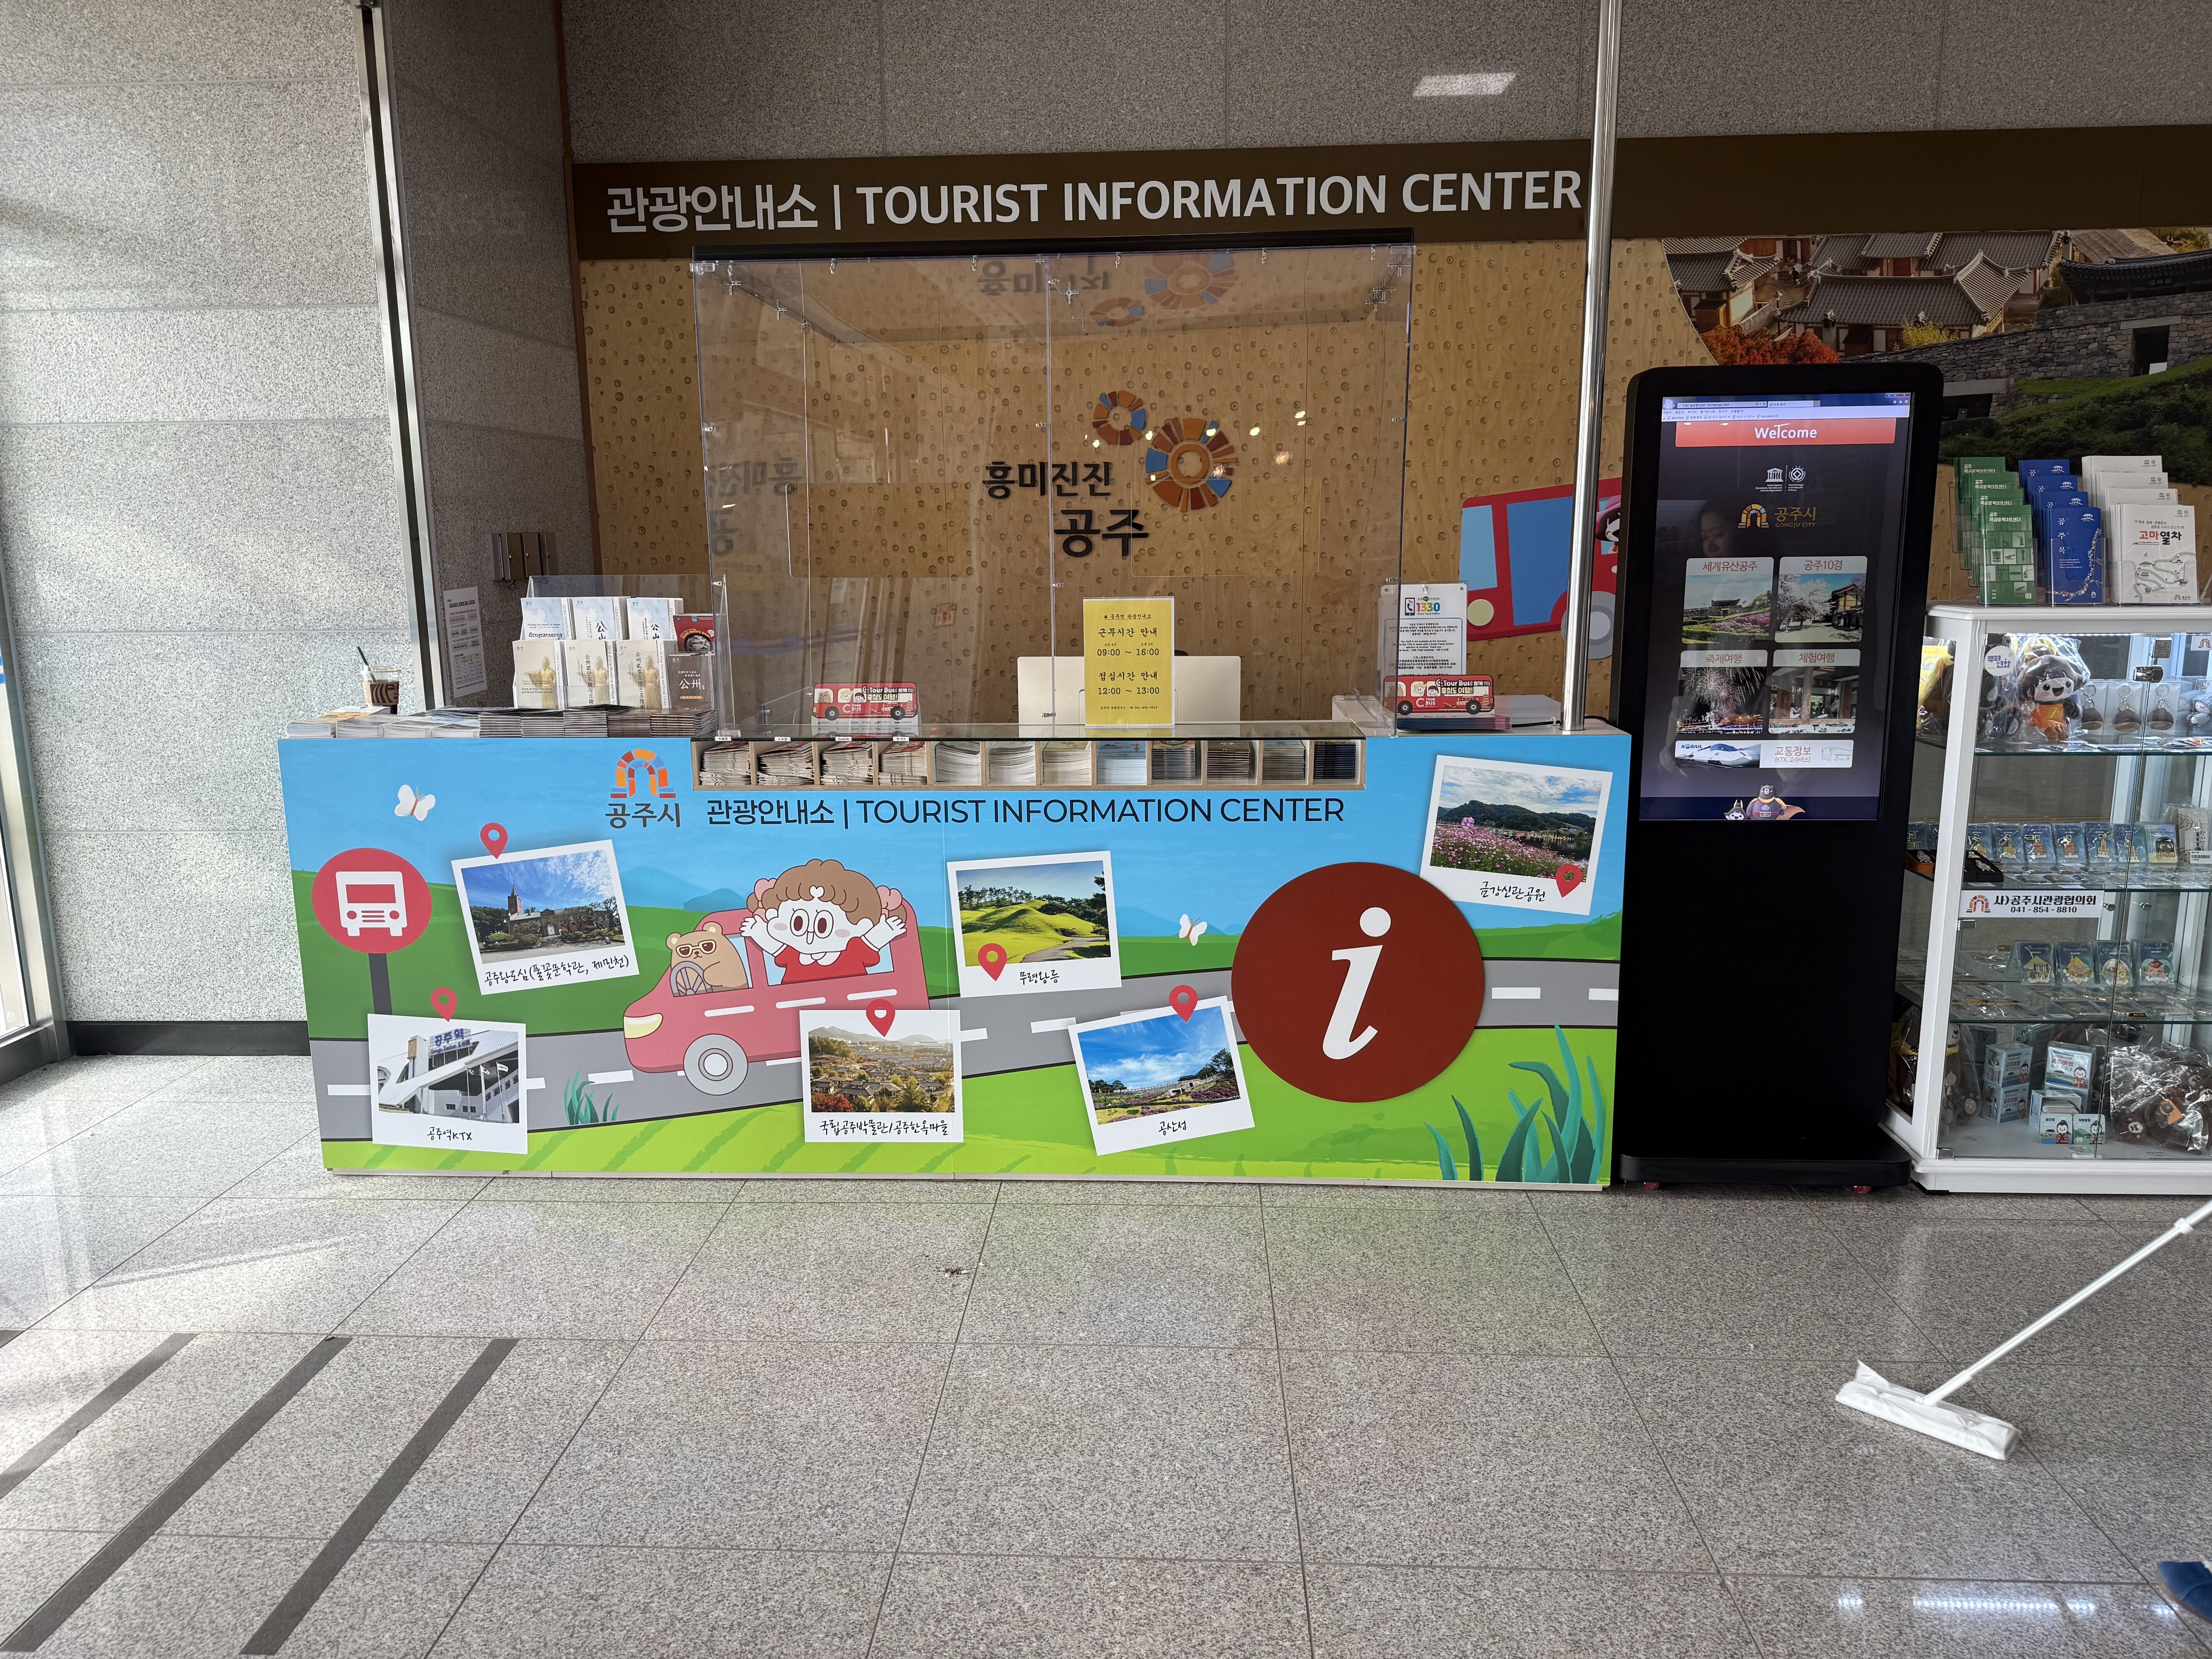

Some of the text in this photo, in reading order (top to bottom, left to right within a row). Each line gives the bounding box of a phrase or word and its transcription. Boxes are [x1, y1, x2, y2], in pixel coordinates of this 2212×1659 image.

[607, 184, 818, 233] 관광안내소
[856, 184, 1047, 225] TOURIST
[1064, 175, 1386, 221] INFORMATION
[1402, 170, 1582, 213] CENTER
[1755, 423, 1817, 440] Welcome
[982, 460, 1112, 499] 흥미진진
[1775, 507, 1816, 522] 공주시
[1054, 508, 1149, 558] 공주
[2139, 531, 2182, 545] 고마열차
[1702, 561, 1758, 572] 세계유산공주
[1804, 560, 1843, 570] 공주10경
[1416, 602, 1440, 612] 1330
[1098, 627, 1157, 637] 근무시간 안내
[1705, 654, 1742, 664] 축제여행
[1799, 653, 1835, 663] 체험여행
[679, 678, 701, 690] 公州
[1098, 672, 1157, 681] 점심시간 안내
[1775, 746, 1811, 756] 교통정보
[605, 802, 681, 829] 공주시
[707, 798, 835, 826] 관광안내소
[856, 799, 986, 825] TOURIST
[994, 798, 1211, 824] INFORMATION
[1220, 798, 1344, 823] CENTER
[1479, 881, 1546, 903] 금강신관공원
[1994, 895, 2096, 905] 사)공주시관광협의회
[484, 955, 629, 986] 공주왕도심(풀꽃문학관, 제민천)
[1019, 969, 1060, 986] 무령왕릉
[434, 1028, 464, 1046] 공주역
[2051, 1058, 2074, 1067] 공주여행
[427, 1127, 473, 1142] 공주역KTX
[820, 1119, 949, 1136] 국립공주박물관/공주한옥마을
[1158, 1119, 1187, 1135] 공산성
